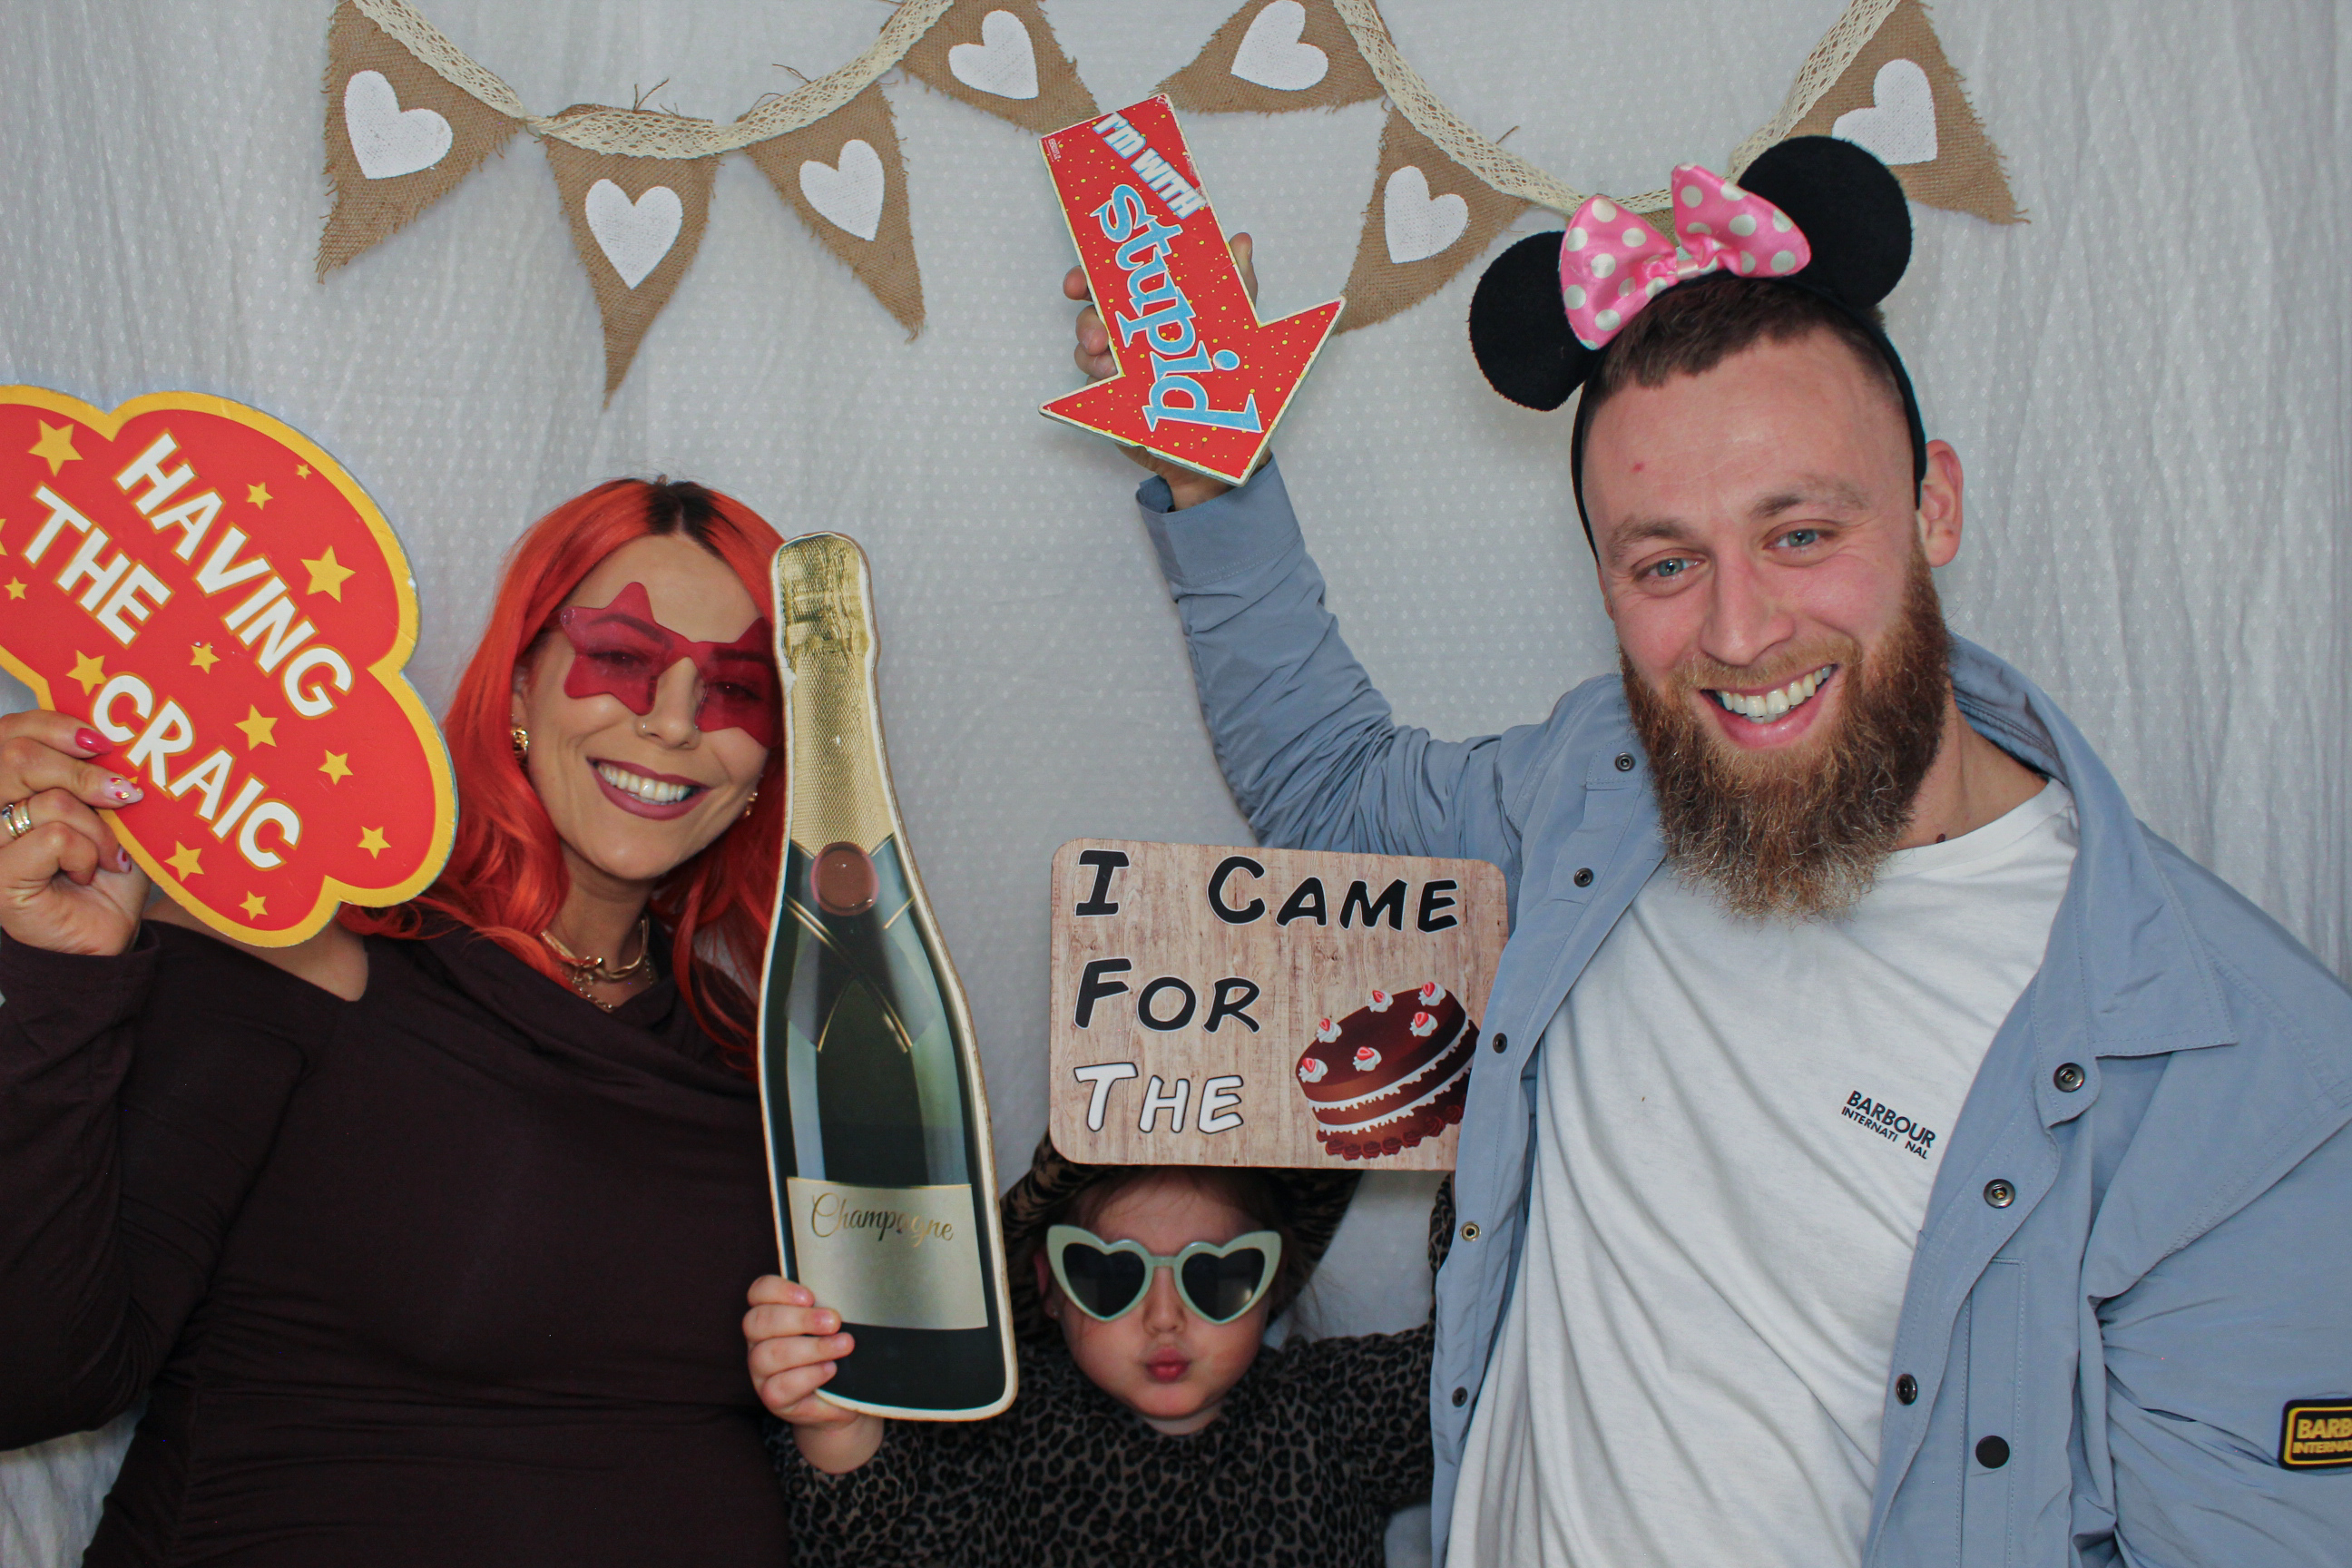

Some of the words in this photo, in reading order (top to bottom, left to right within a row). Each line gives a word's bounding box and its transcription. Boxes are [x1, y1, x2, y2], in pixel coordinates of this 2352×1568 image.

[1130, 147, 1208, 220] WITH
[1090, 184, 1262, 433] stupid
[22, 483, 174, 648] THE
[114, 428, 353, 719] HAVING
[92, 672, 301, 869] CRAIC
[1075, 849, 1130, 916] I
[1846, 1090, 1936, 1149] BARBOUR
[811, 1191, 954, 1248] Champagne
